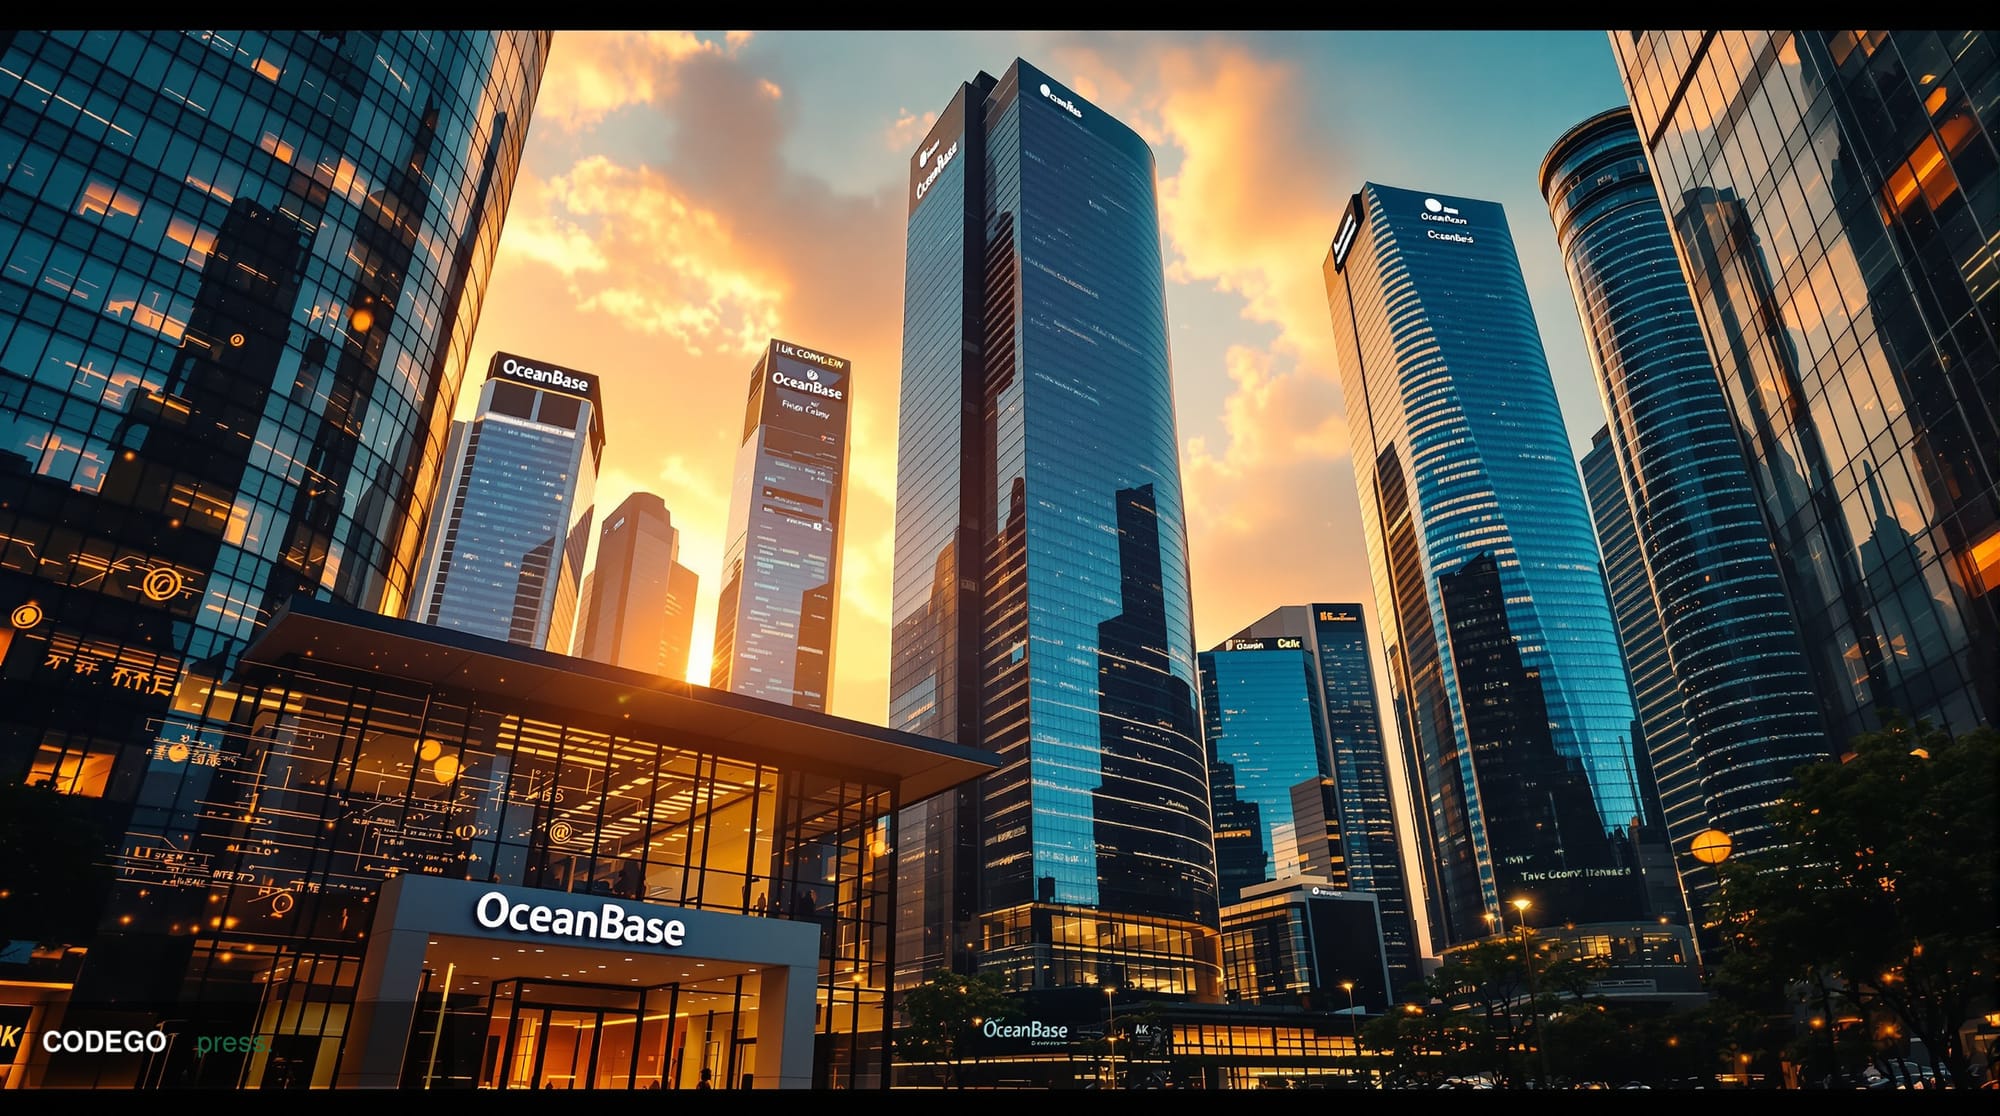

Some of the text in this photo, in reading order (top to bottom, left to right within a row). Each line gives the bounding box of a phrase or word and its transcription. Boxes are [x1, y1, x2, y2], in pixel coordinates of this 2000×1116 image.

[502, 359, 589, 392] OceanBase
[772, 371, 843, 400] OceanBase
[476, 891, 686, 947] OceanBase
[983, 1020, 1068, 1039] OceanBase
